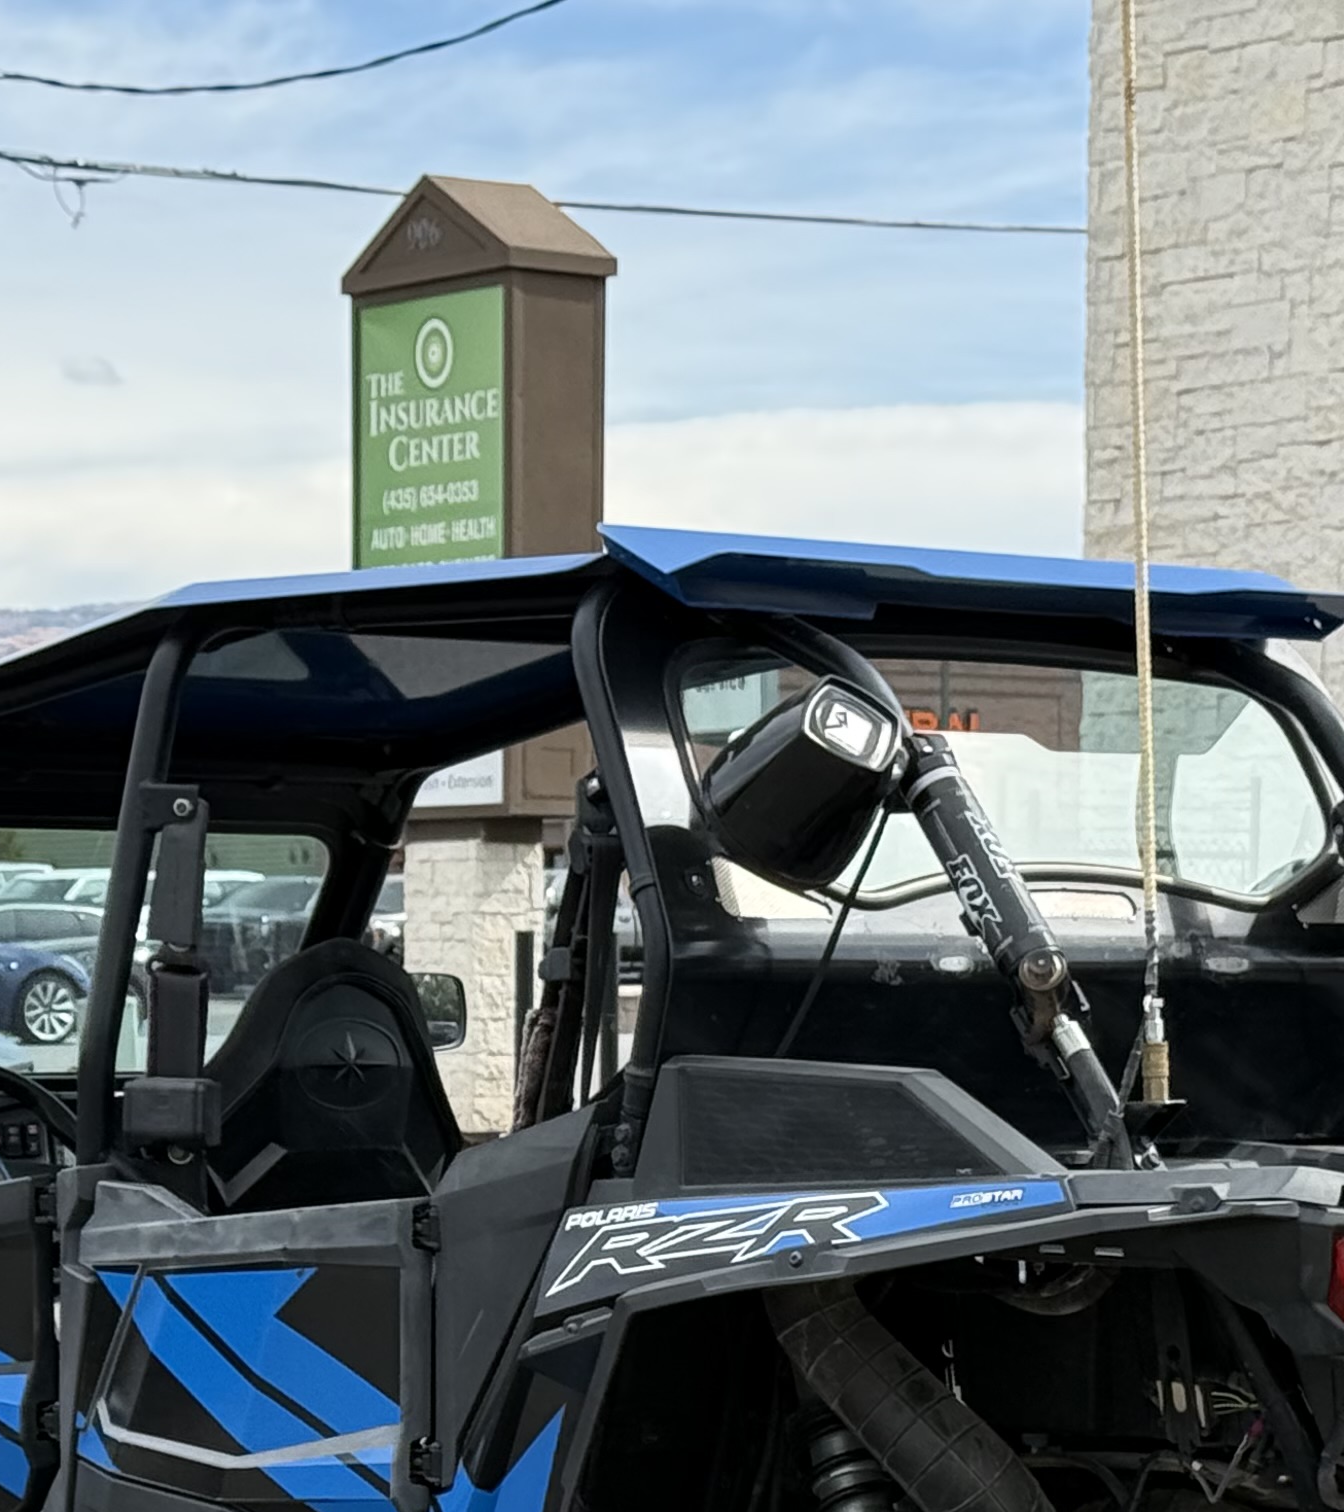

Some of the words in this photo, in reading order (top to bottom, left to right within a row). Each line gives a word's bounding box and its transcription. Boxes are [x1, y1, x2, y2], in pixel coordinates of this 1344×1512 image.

[366, 370, 405, 399] THE
[369, 387, 499, 437] INSURANCE
[388, 430, 481, 472] CENTER
[382, 487, 417, 515] (435)
[371, 526, 407, 551] AUTO
[410, 521, 447, 547] HOME
[451, 515, 496, 543] HEALTH
[946, 853, 1002, 939] FOX
[565, 1202, 659, 1231] POLARIS
[950, 1189, 1023, 1208] PROSTAR
[545, 1191, 889, 1298] RZR
